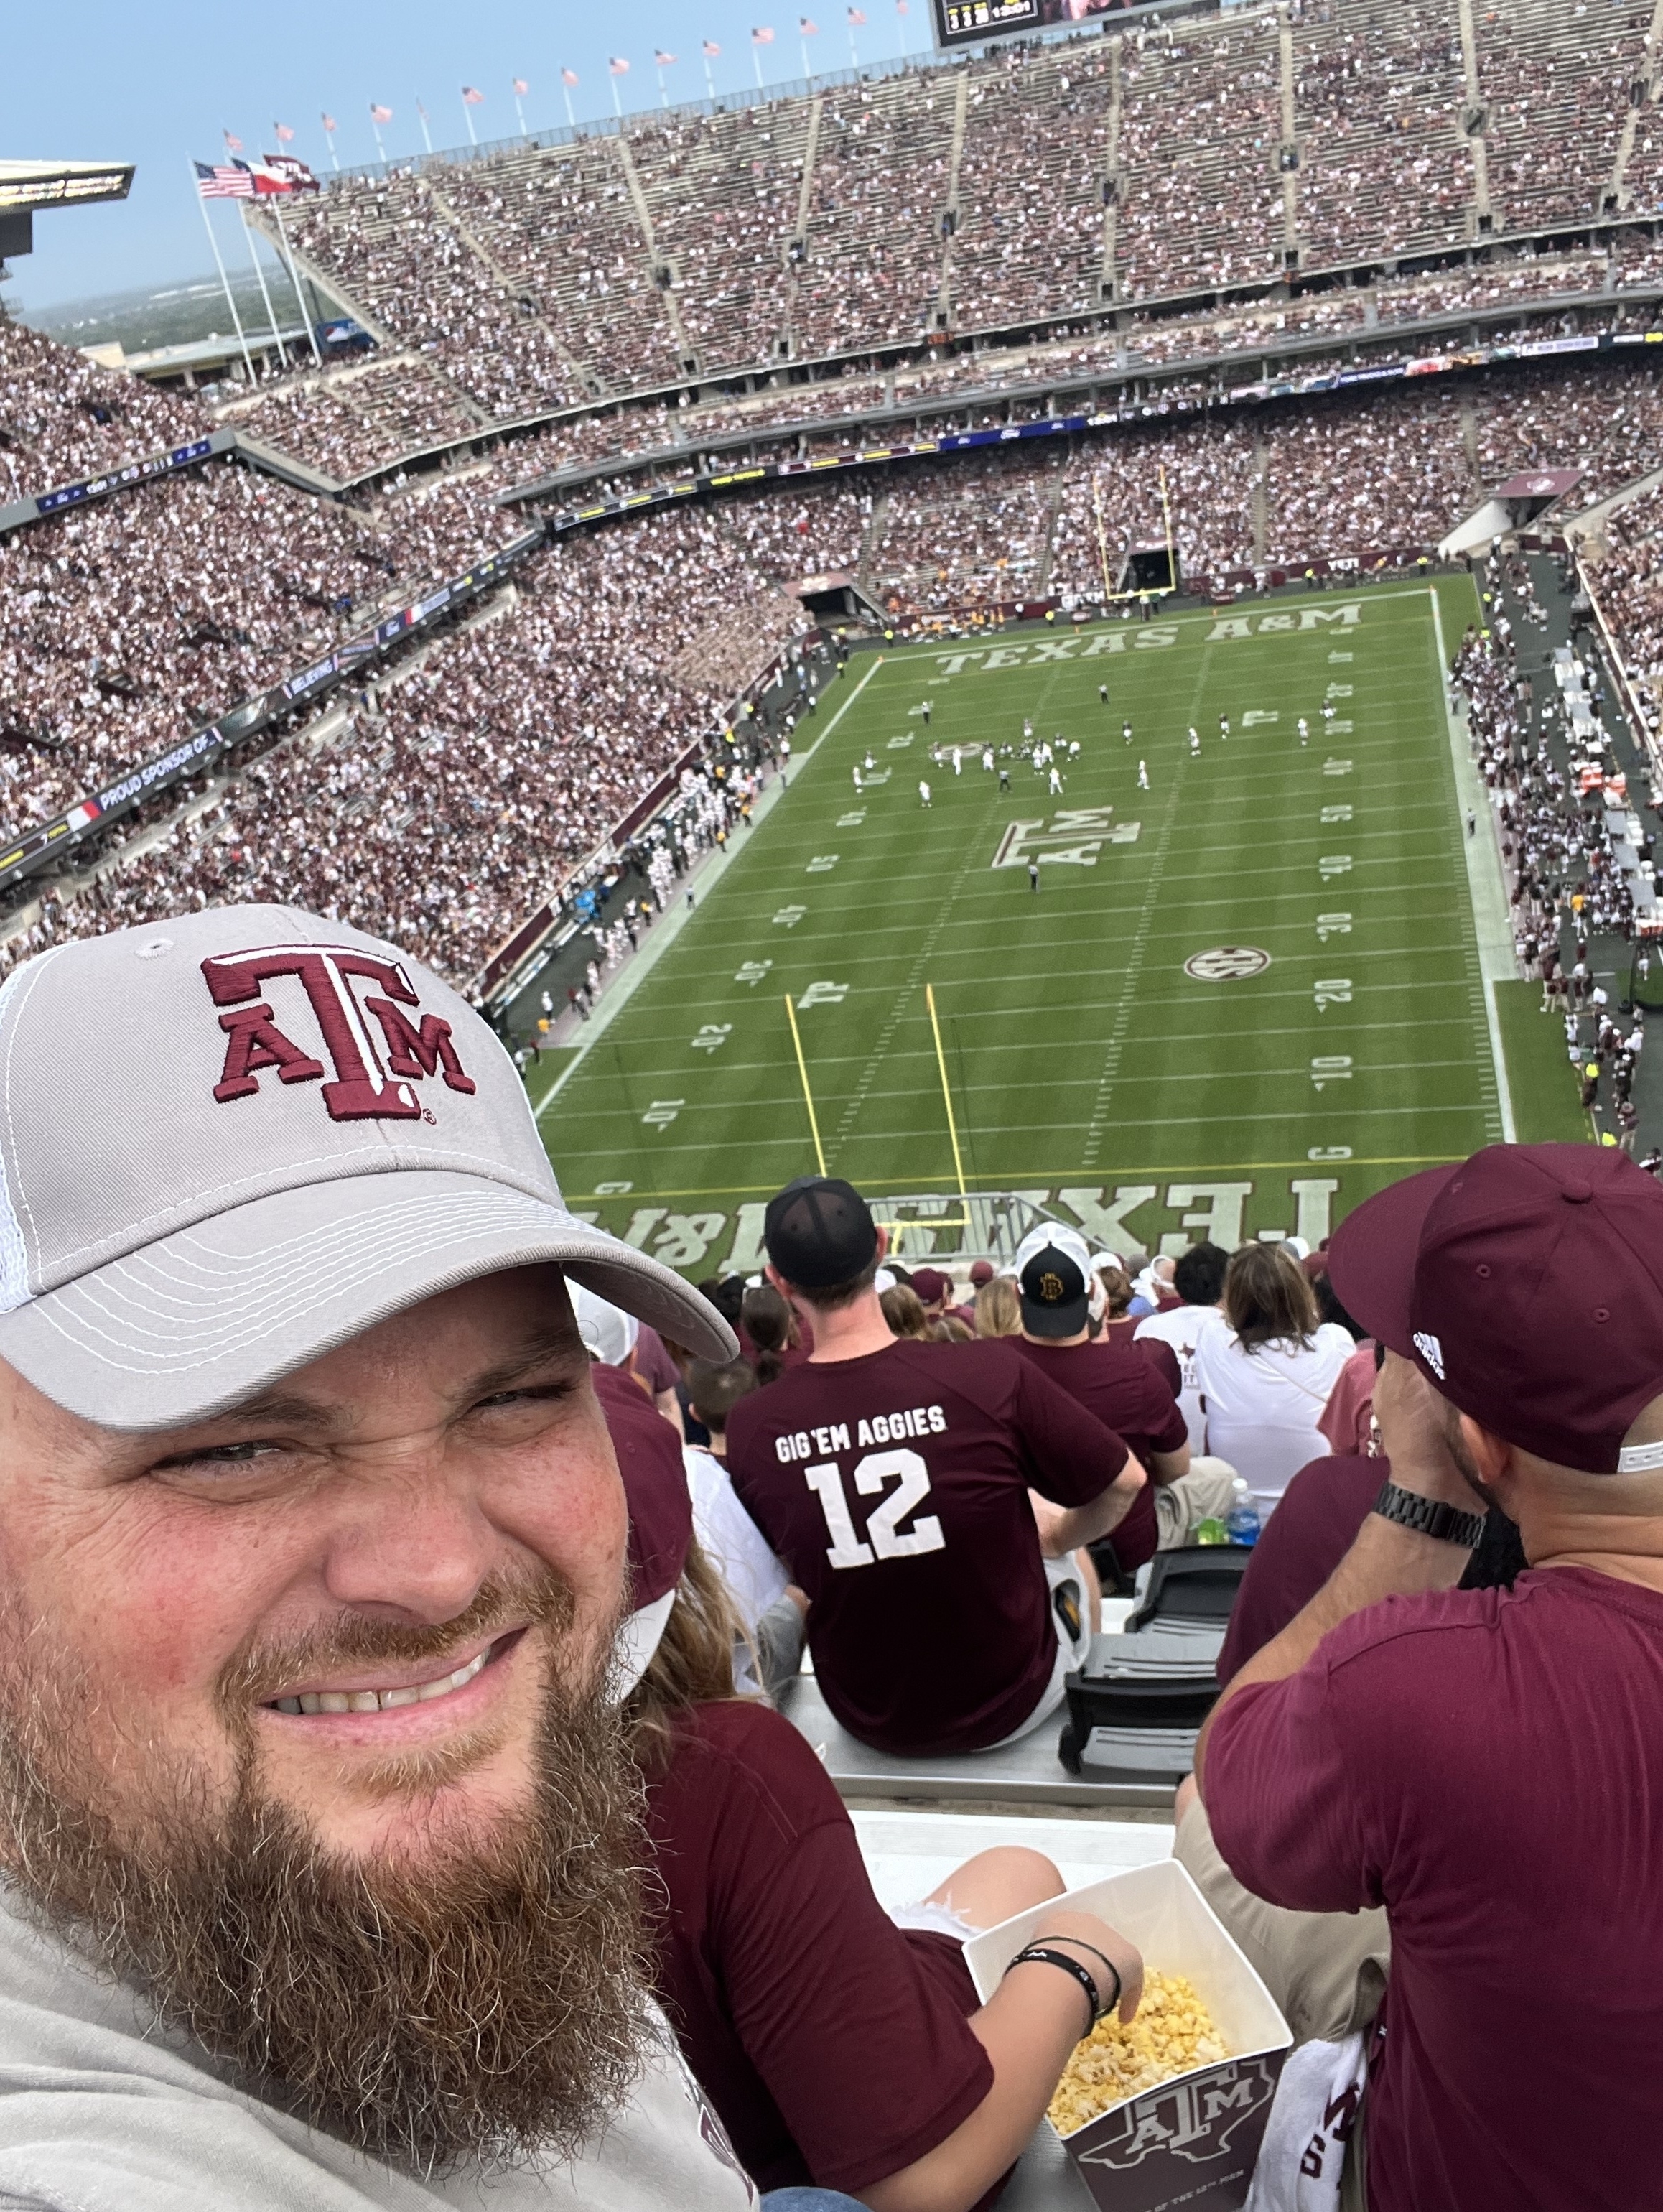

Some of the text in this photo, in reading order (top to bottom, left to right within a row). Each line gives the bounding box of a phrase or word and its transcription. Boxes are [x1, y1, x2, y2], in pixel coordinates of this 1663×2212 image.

[1327, 557, 1359, 572] YETI
[936, 603, 1362, 676] TEXAS A&M
[99, 774, 143, 811] PROUD
[141, 743, 195, 786] SPONSOR
[1320, 804, 1353, 823] 50
[1318, 855, 1353, 875] 40
[1316, 912, 1353, 934] 30
[734, 959, 773, 982] 30
[1313, 977, 1353, 1003] 20
[691, 1023, 733, 1049] 20
[1310, 1055, 1354, 1080] 10
[641, 1098, 686, 1125] 10
[1307, 1145, 1354, 1161] 5
[1412, 1332, 1446, 1380] adidas
[775, 1404, 948, 1464] GIG 'EM AGGIES
[803, 1447, 946, 1571] 12
